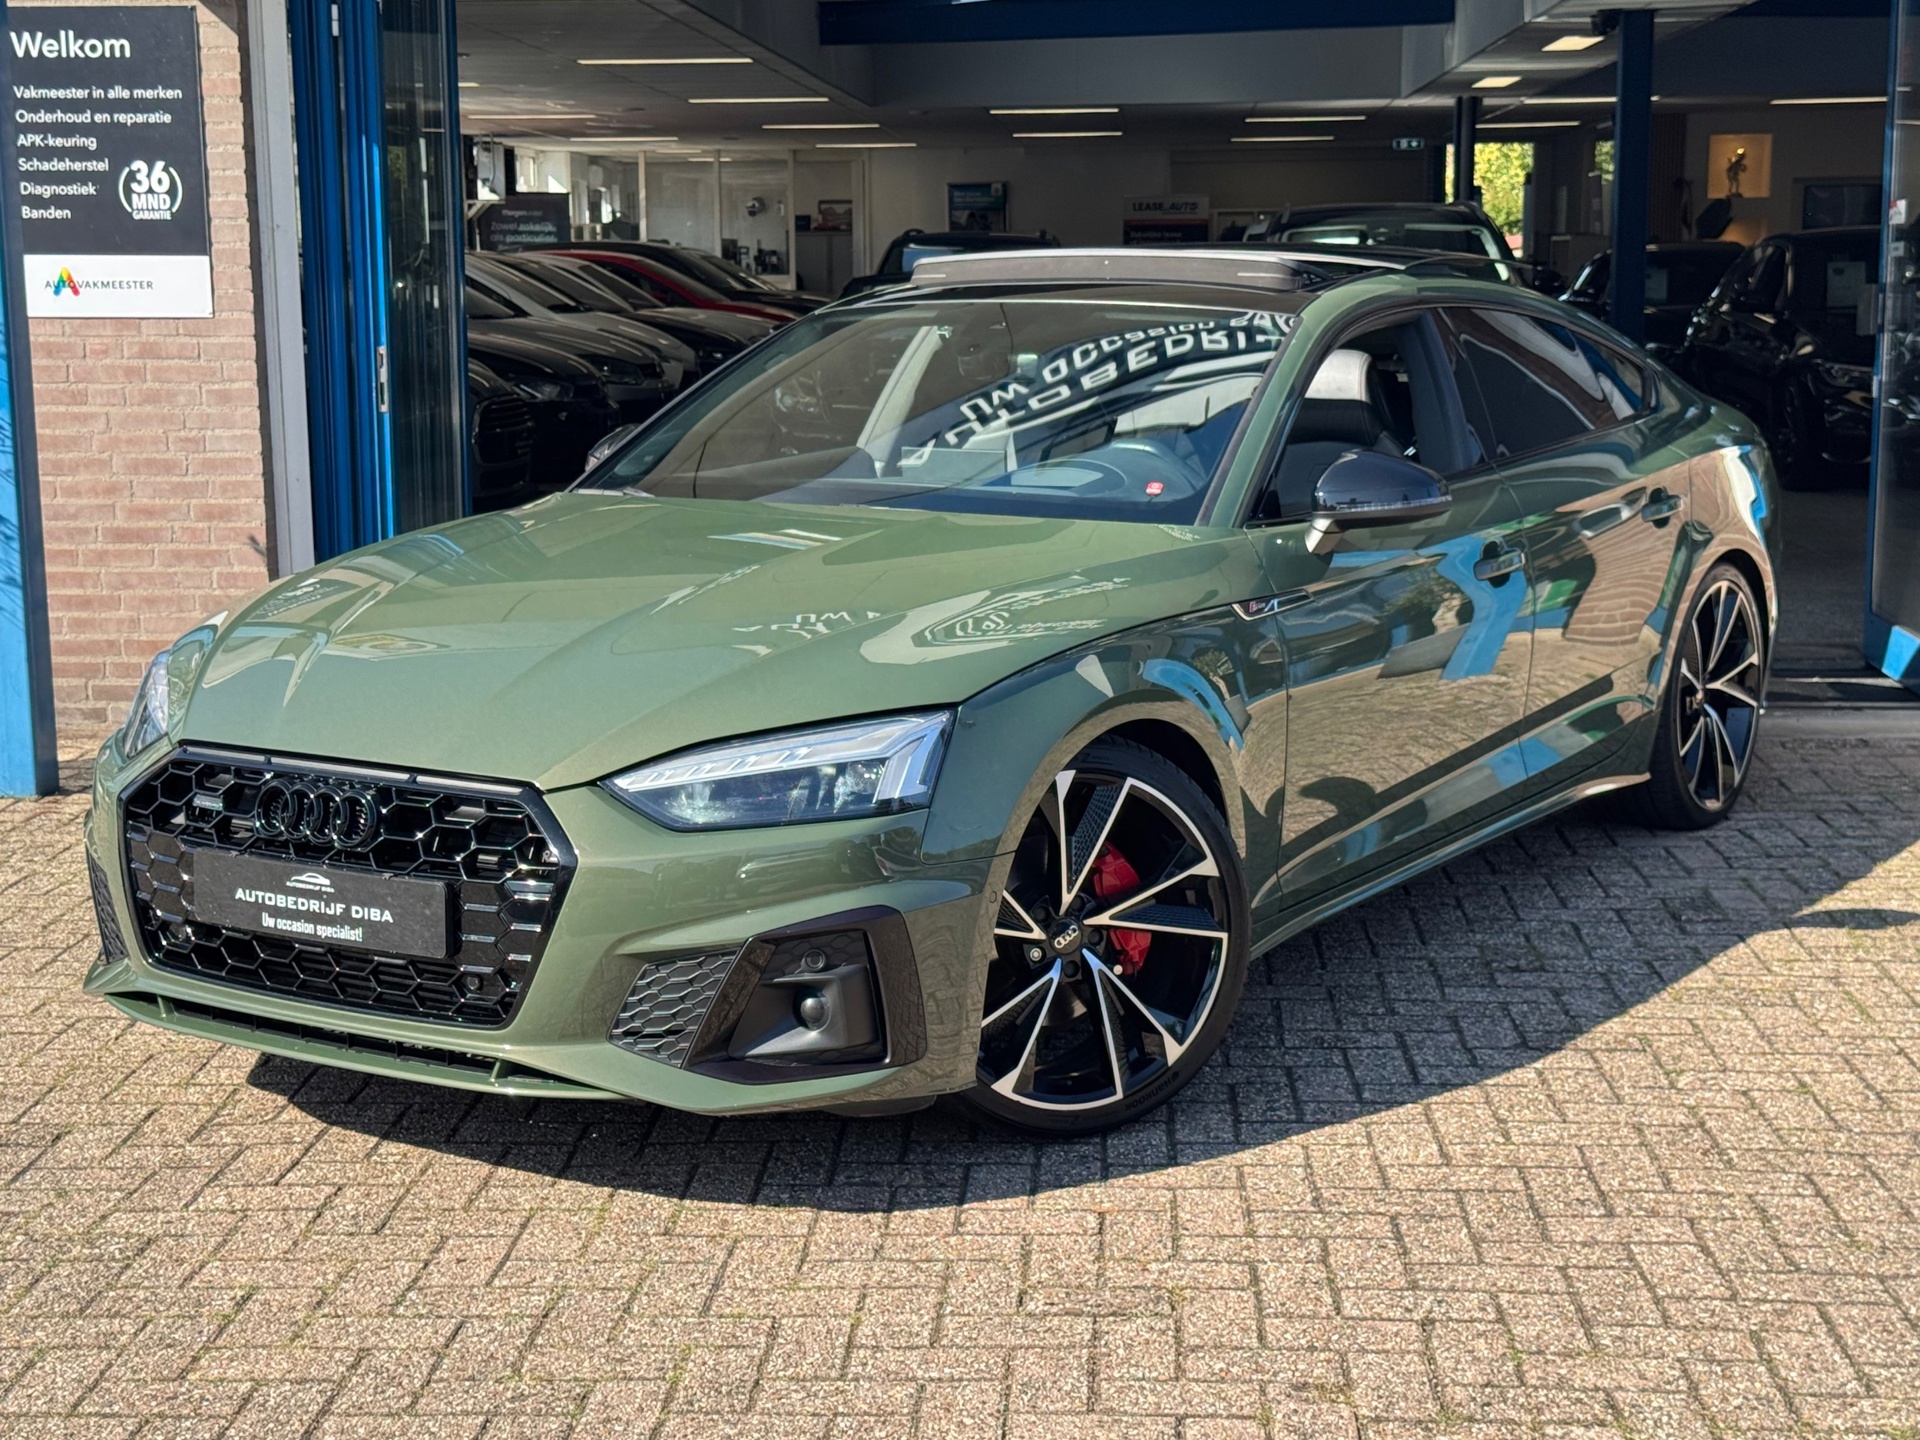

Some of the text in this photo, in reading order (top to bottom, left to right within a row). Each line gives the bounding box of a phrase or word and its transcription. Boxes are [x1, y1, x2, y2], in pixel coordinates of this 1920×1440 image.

[9, 29, 131, 58] Welkom
[13, 85, 183, 99] Vakmeester in alle merken
[15, 109, 172, 127] Onderhoud en reparatie
[17, 134, 97, 151] APK-keuring
[18, 157, 109, 171] Schadeherstel
[130, 160, 170, 193] 36
[20, 181, 97, 199] Diagnostiek
[132, 193, 171, 210] MND
[1132, 202, 1164, 211] LEASE
[21, 205, 71, 219] Banden
[132, 210, 172, 220] GARANTIE
[235, 888, 394, 924] AUTOBEDRIJF DIBA
[261, 912, 363, 942] Uw occasion specialist!
